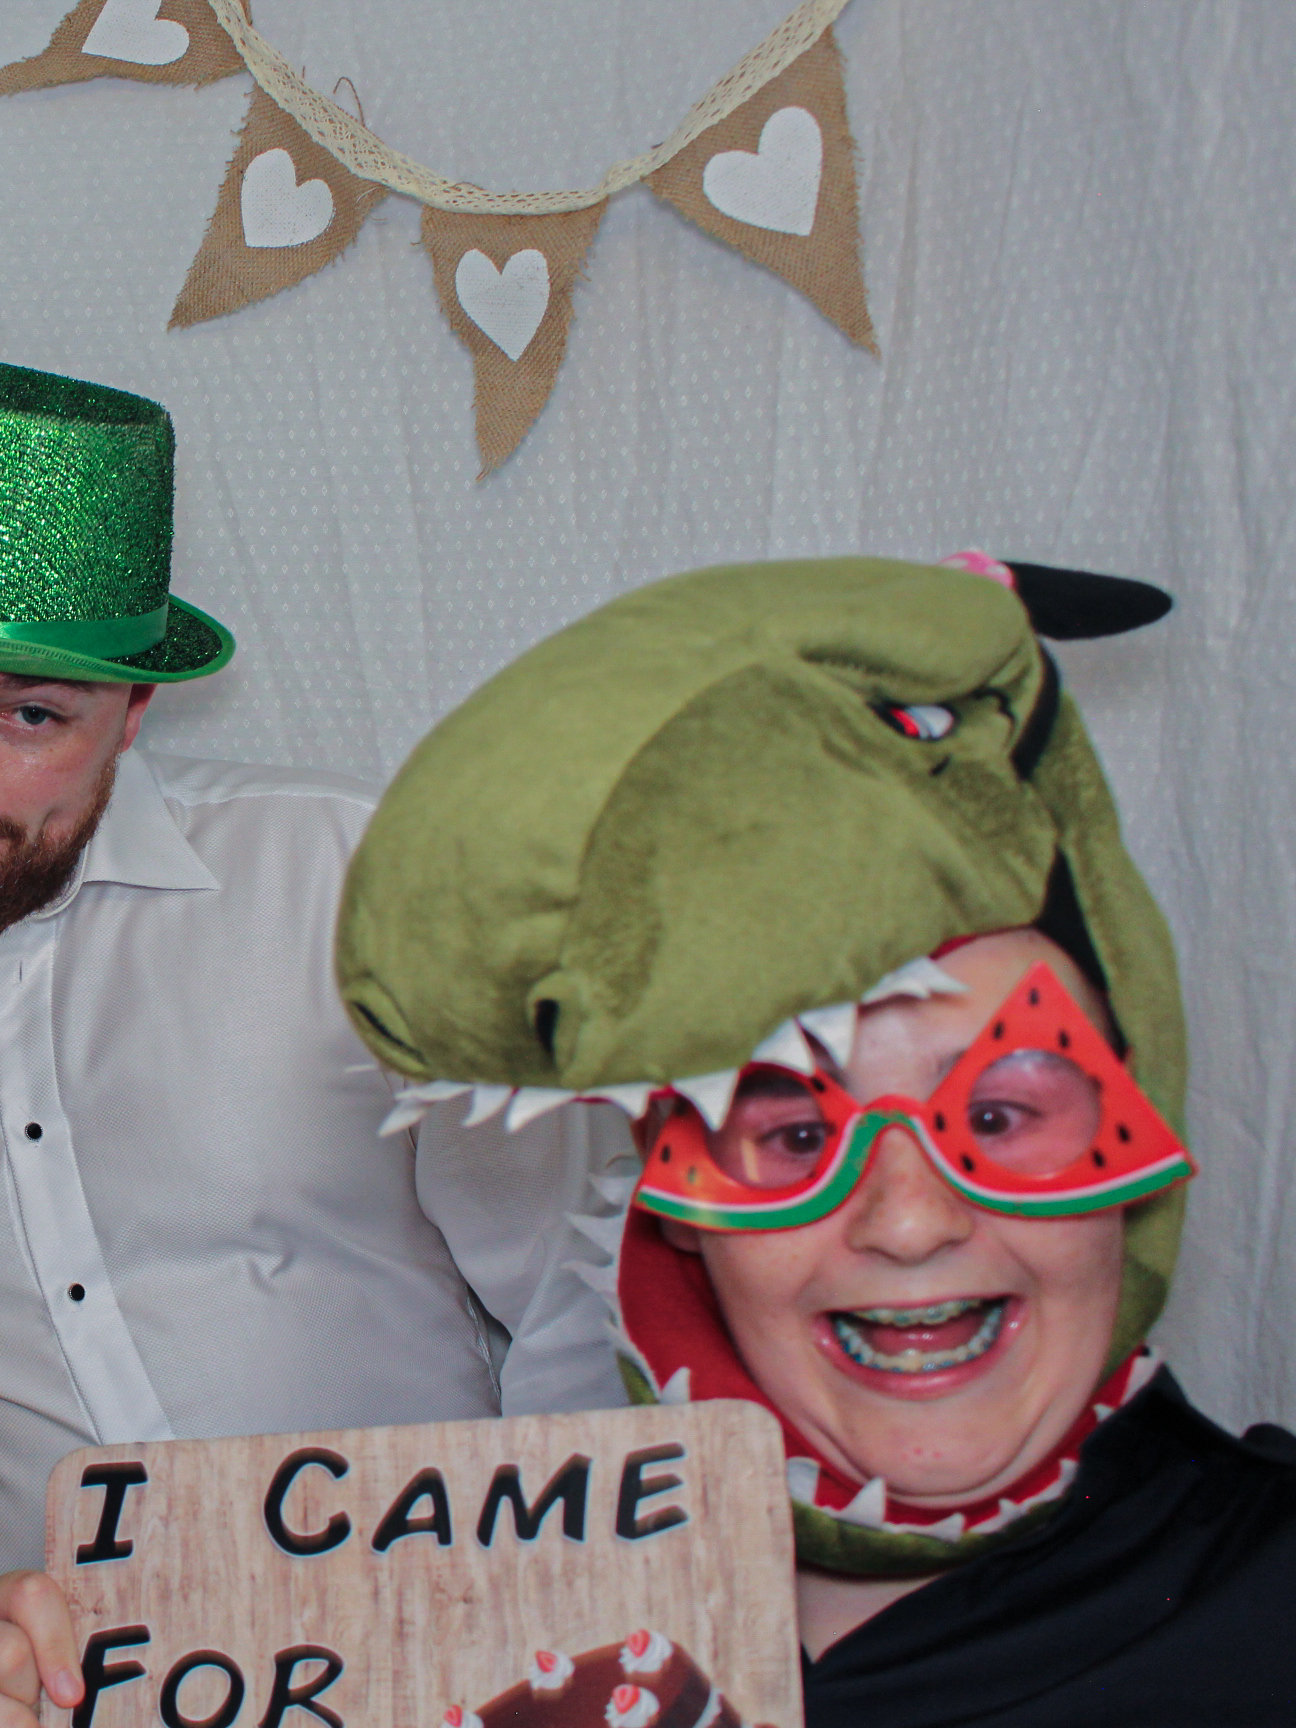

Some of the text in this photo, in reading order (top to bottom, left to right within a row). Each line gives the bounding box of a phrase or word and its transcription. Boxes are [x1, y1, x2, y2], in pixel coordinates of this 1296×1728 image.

[76, 1442, 689, 1565] I CAME
[71, 1624, 344, 1728] FOR
